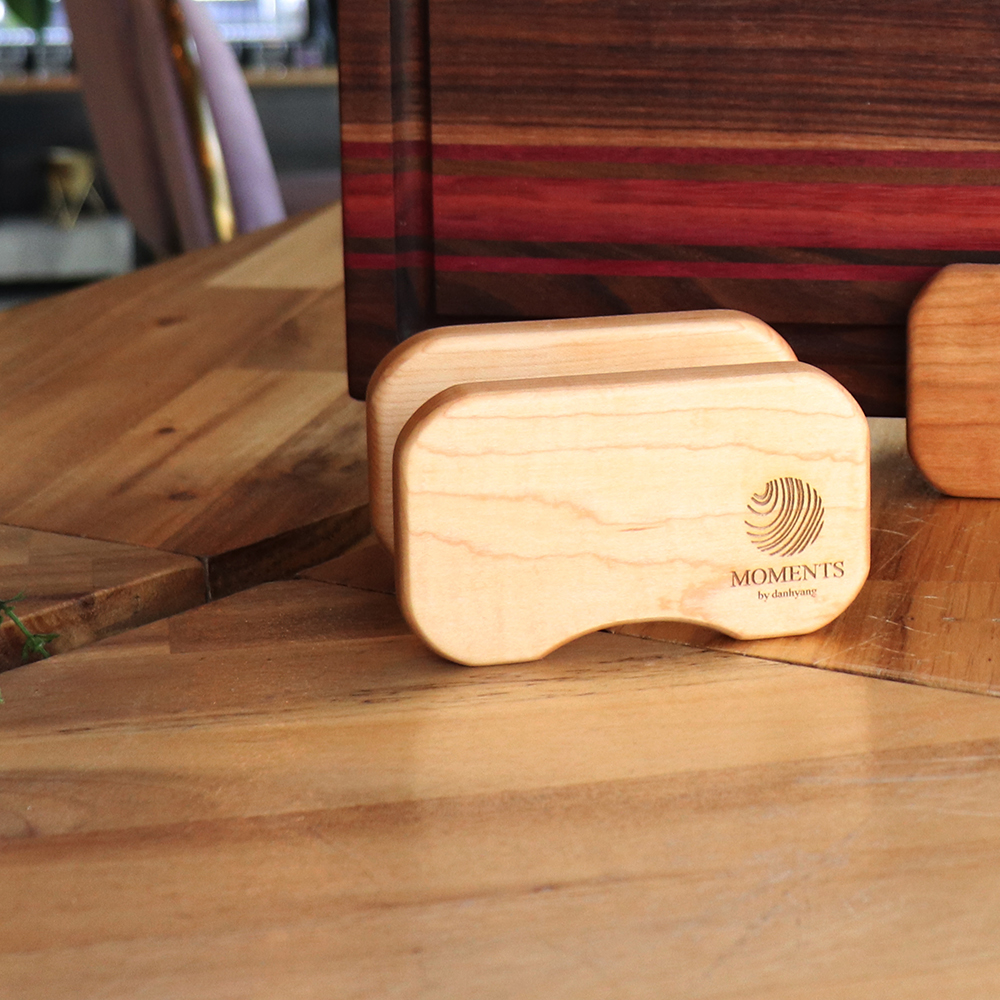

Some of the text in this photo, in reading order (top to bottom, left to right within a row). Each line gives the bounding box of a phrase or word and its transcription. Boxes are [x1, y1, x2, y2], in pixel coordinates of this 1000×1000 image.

[730, 560, 845, 588] MOMENTS
[757, 588, 818, 602] by danhyang
